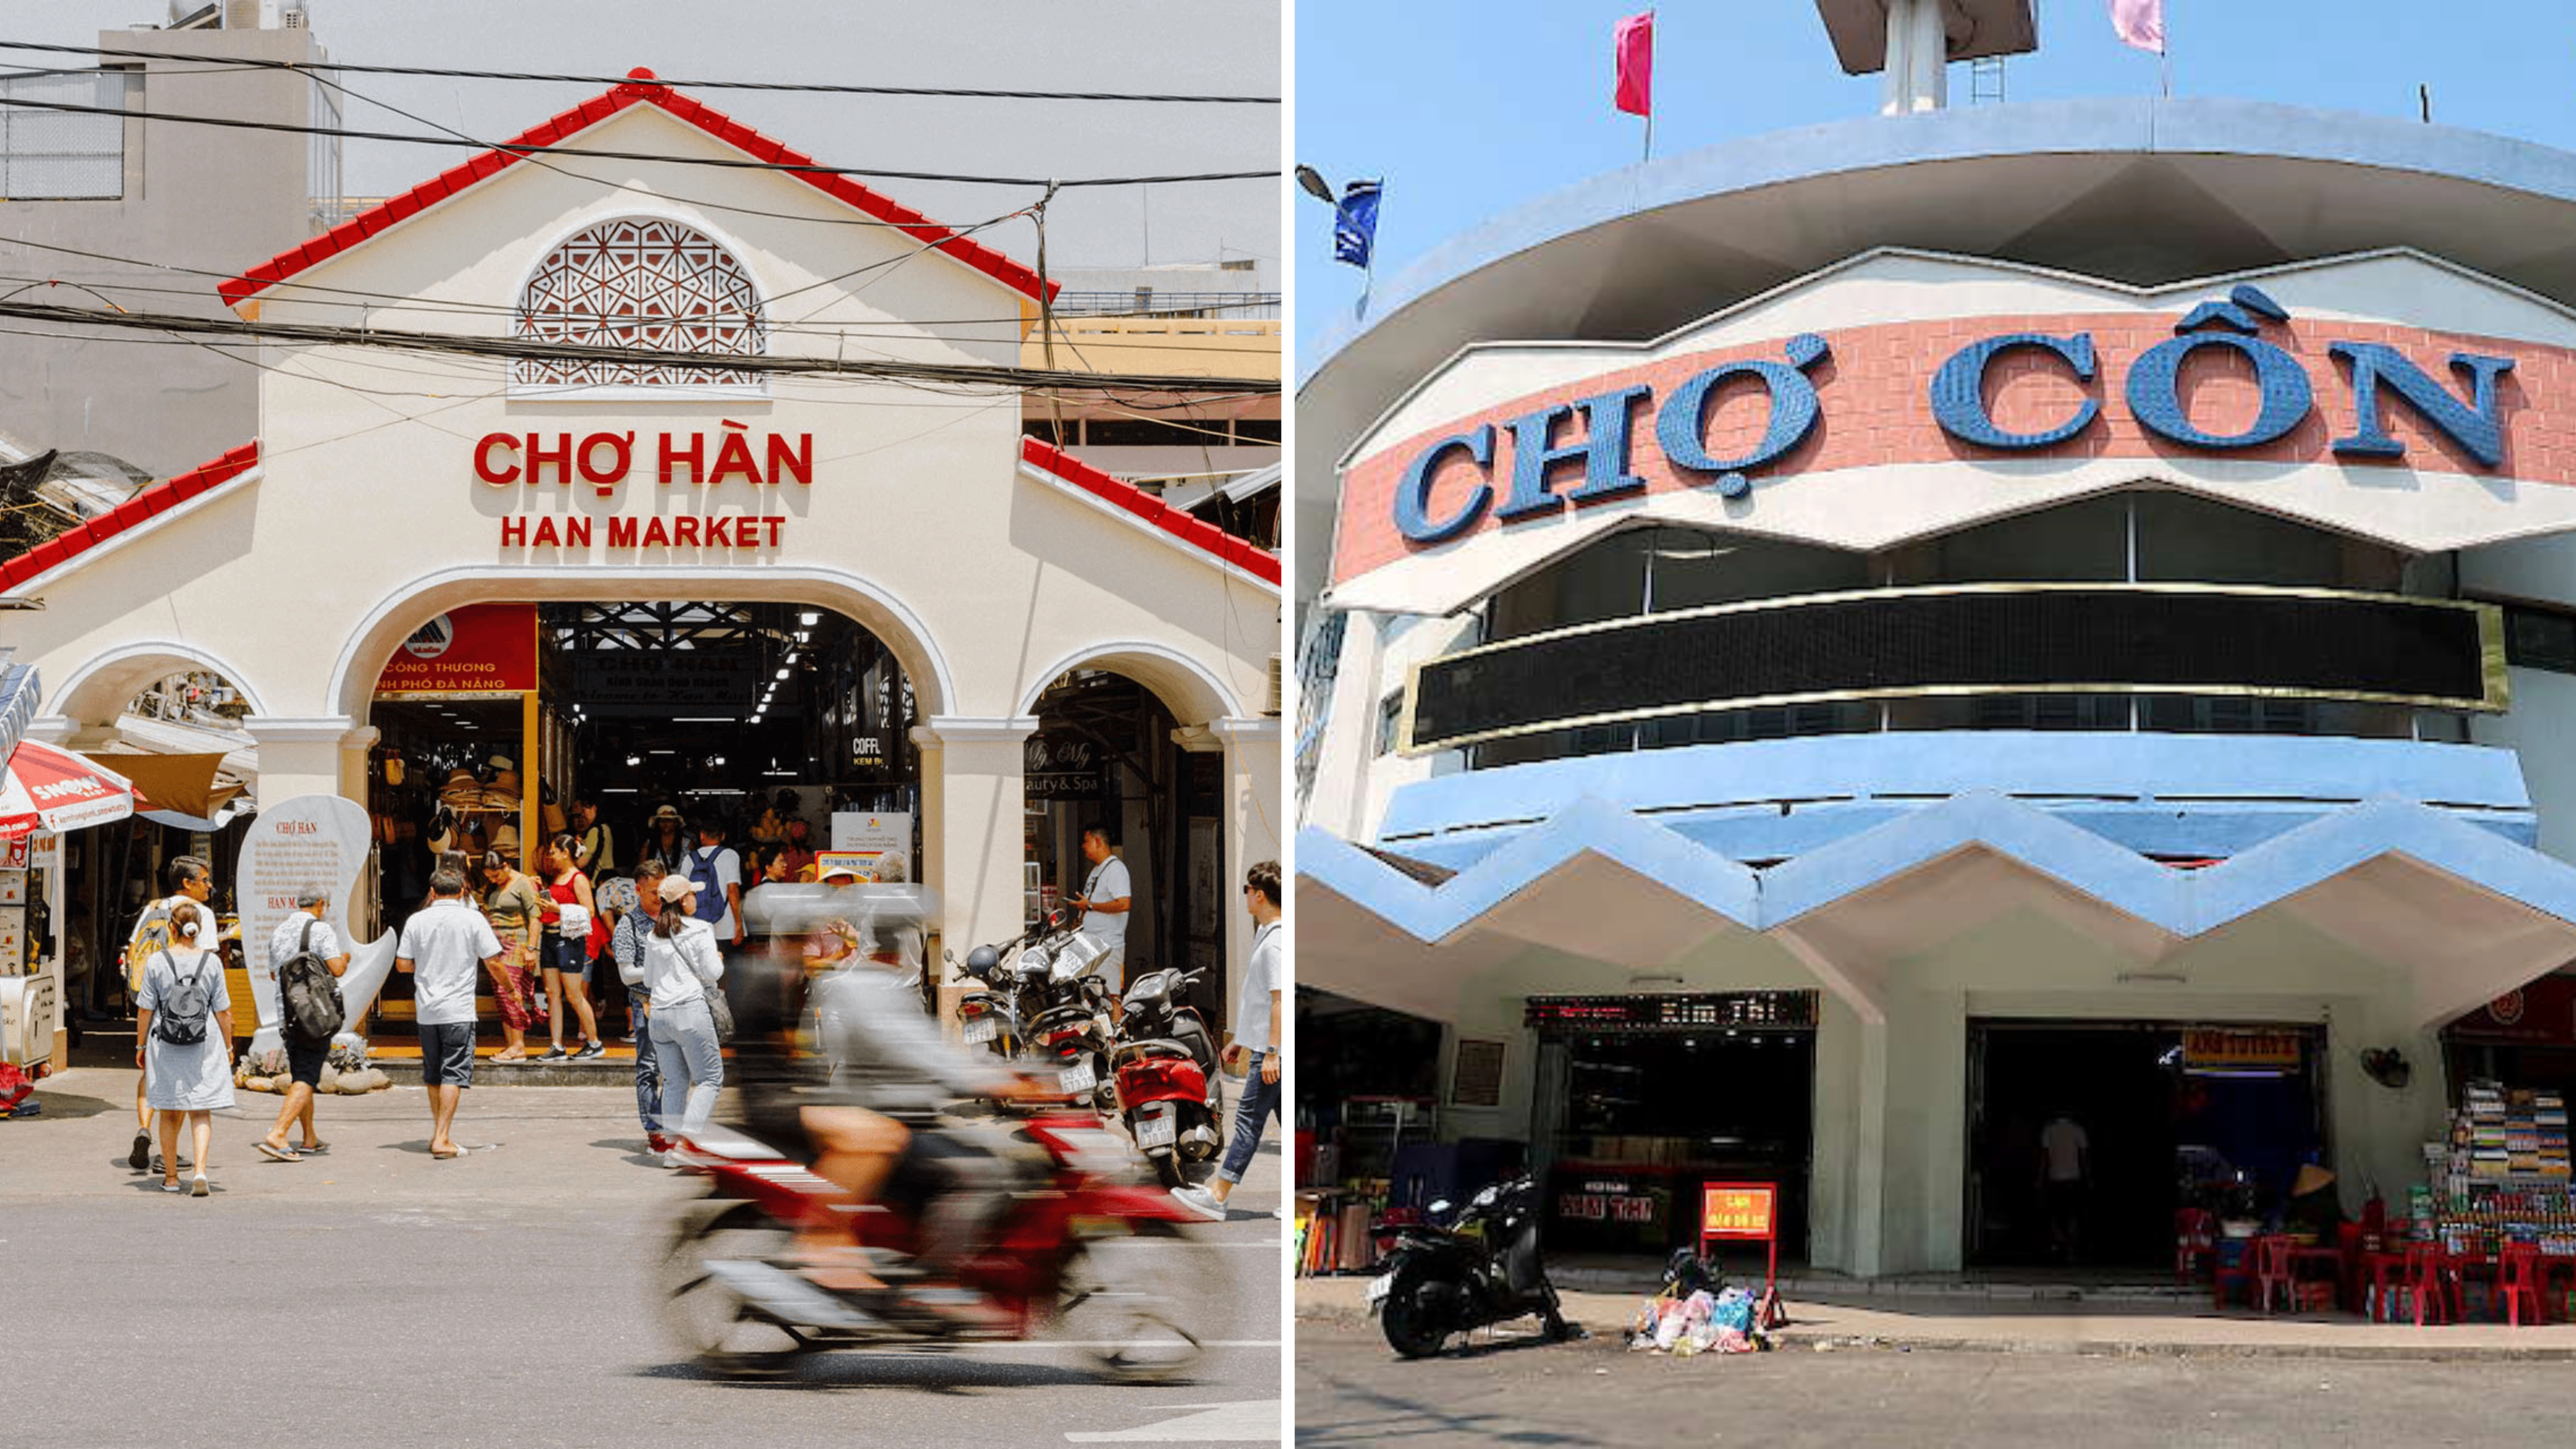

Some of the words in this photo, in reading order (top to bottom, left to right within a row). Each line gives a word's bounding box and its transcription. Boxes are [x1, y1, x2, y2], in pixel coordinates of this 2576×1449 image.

[1394, 332, 1832, 546] CHỢ
[1932, 283, 2515, 471] CỒN
[474, 431, 635, 496] CHỢ
[659, 419, 812, 484] HÀN
[502, 516, 591, 547] HAN
[609, 516, 785, 547] MARKET
[385, 661, 428, 672] CÔNG
[436, 662, 496, 672] THƯƠNG
[401, 676, 432, 689] PHỐ
[436, 678, 457, 689] ĐÀ
[462, 677, 505, 689] NẴNG
[854, 757, 872, 766] KEM
[31, 775, 101, 800] SNOW
[1026, 778, 1057, 793] auty
[1074, 776, 1097, 793] Spa
[276, 820, 295, 836] CHỢ
[268, 896, 285, 909] HAN
